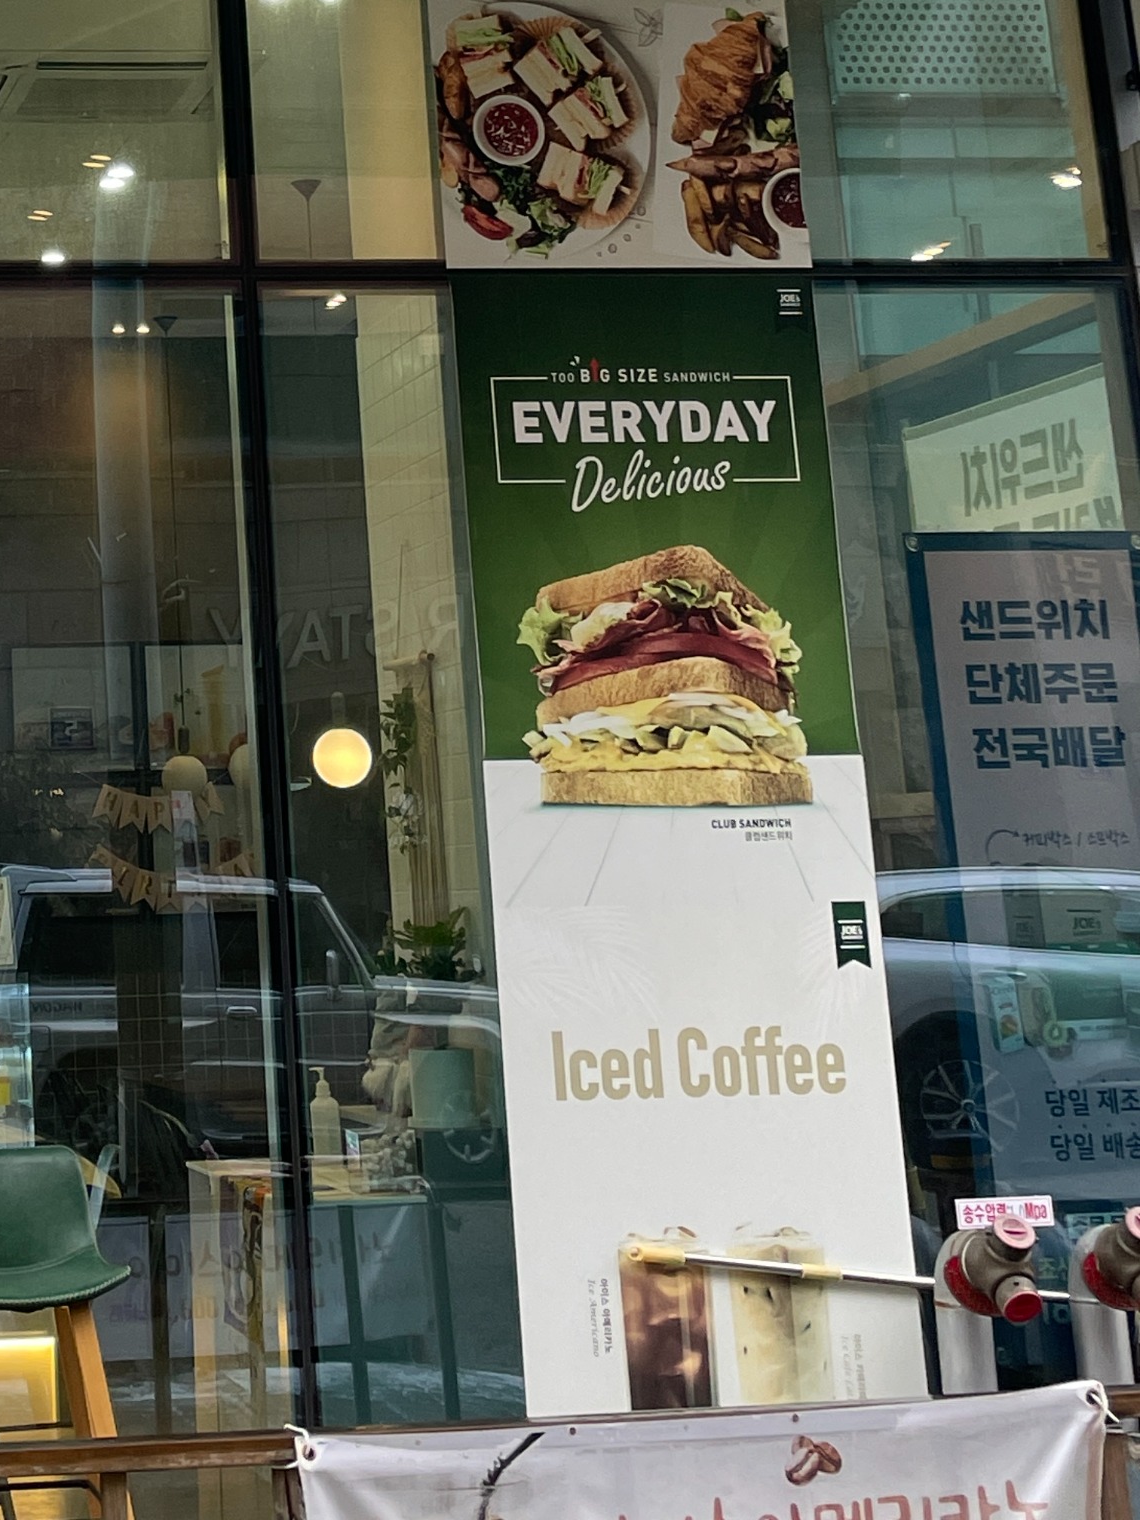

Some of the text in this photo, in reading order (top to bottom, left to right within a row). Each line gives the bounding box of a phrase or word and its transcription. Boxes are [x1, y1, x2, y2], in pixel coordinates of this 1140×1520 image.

[550, 372, 575, 383] TOO
[617, 368, 659, 383] SIZE
[663, 371, 731, 383] SANDWICH
[511, 399, 777, 444] EVERYDAY
[570, 448, 731, 513] Delicious
[960, 598, 1110, 642] 샌드위치
[965, 661, 1119, 706] 단체주문
[972, 725, 1127, 770] 전국배달
[710, 817, 792, 829] CLUB SANDWICH
[551, 1025, 847, 1102] Iced Coffee
[1044, 1087, 1091, 1119] 당일
[1050, 1132, 1096, 1162] 당일
